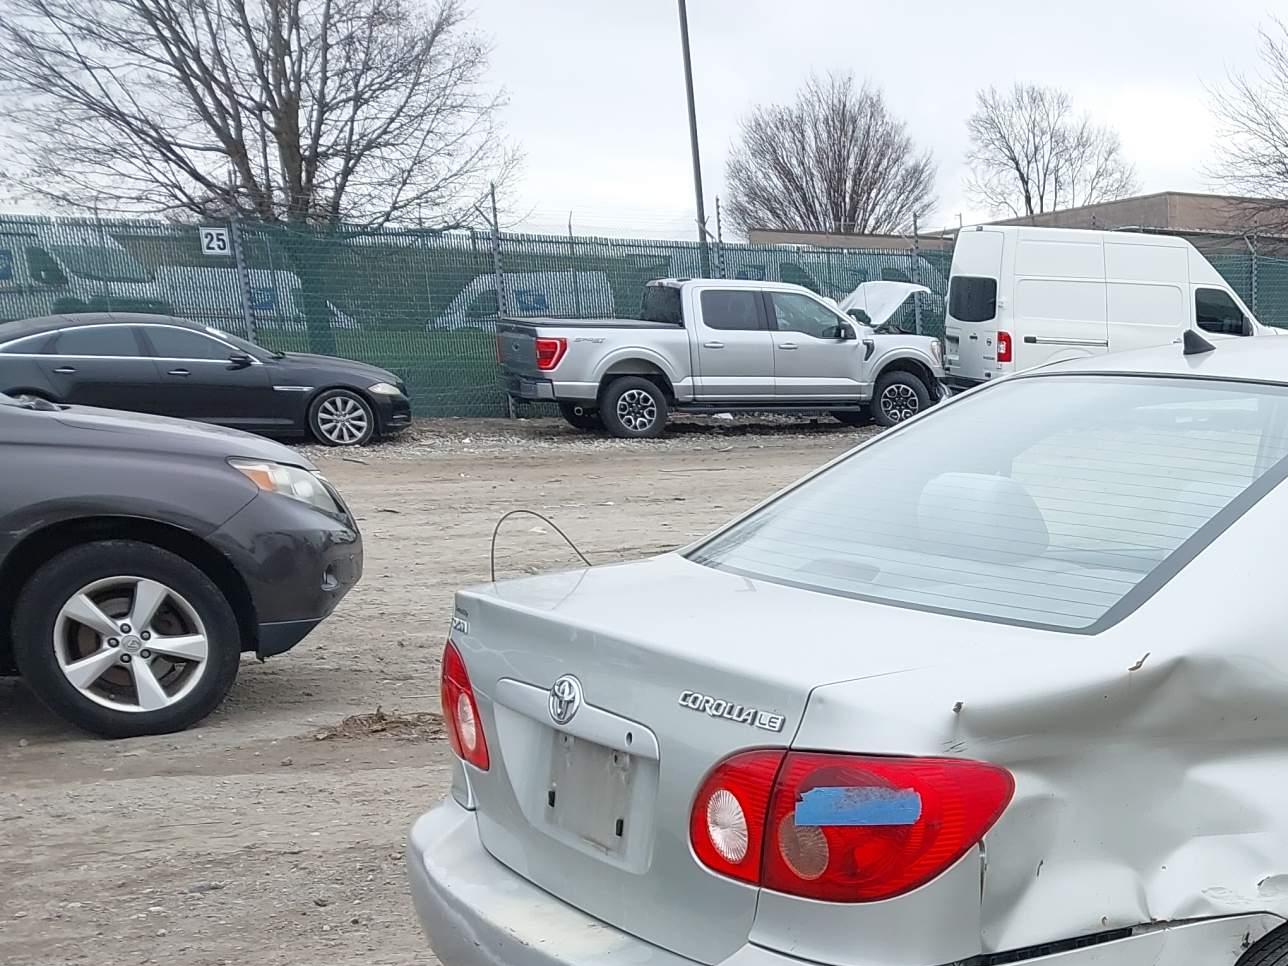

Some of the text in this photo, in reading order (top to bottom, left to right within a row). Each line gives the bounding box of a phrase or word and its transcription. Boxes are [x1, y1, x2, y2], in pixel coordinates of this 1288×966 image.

[204, 231, 227, 251] 25
[678, 690, 785, 732] COROLLA LE
